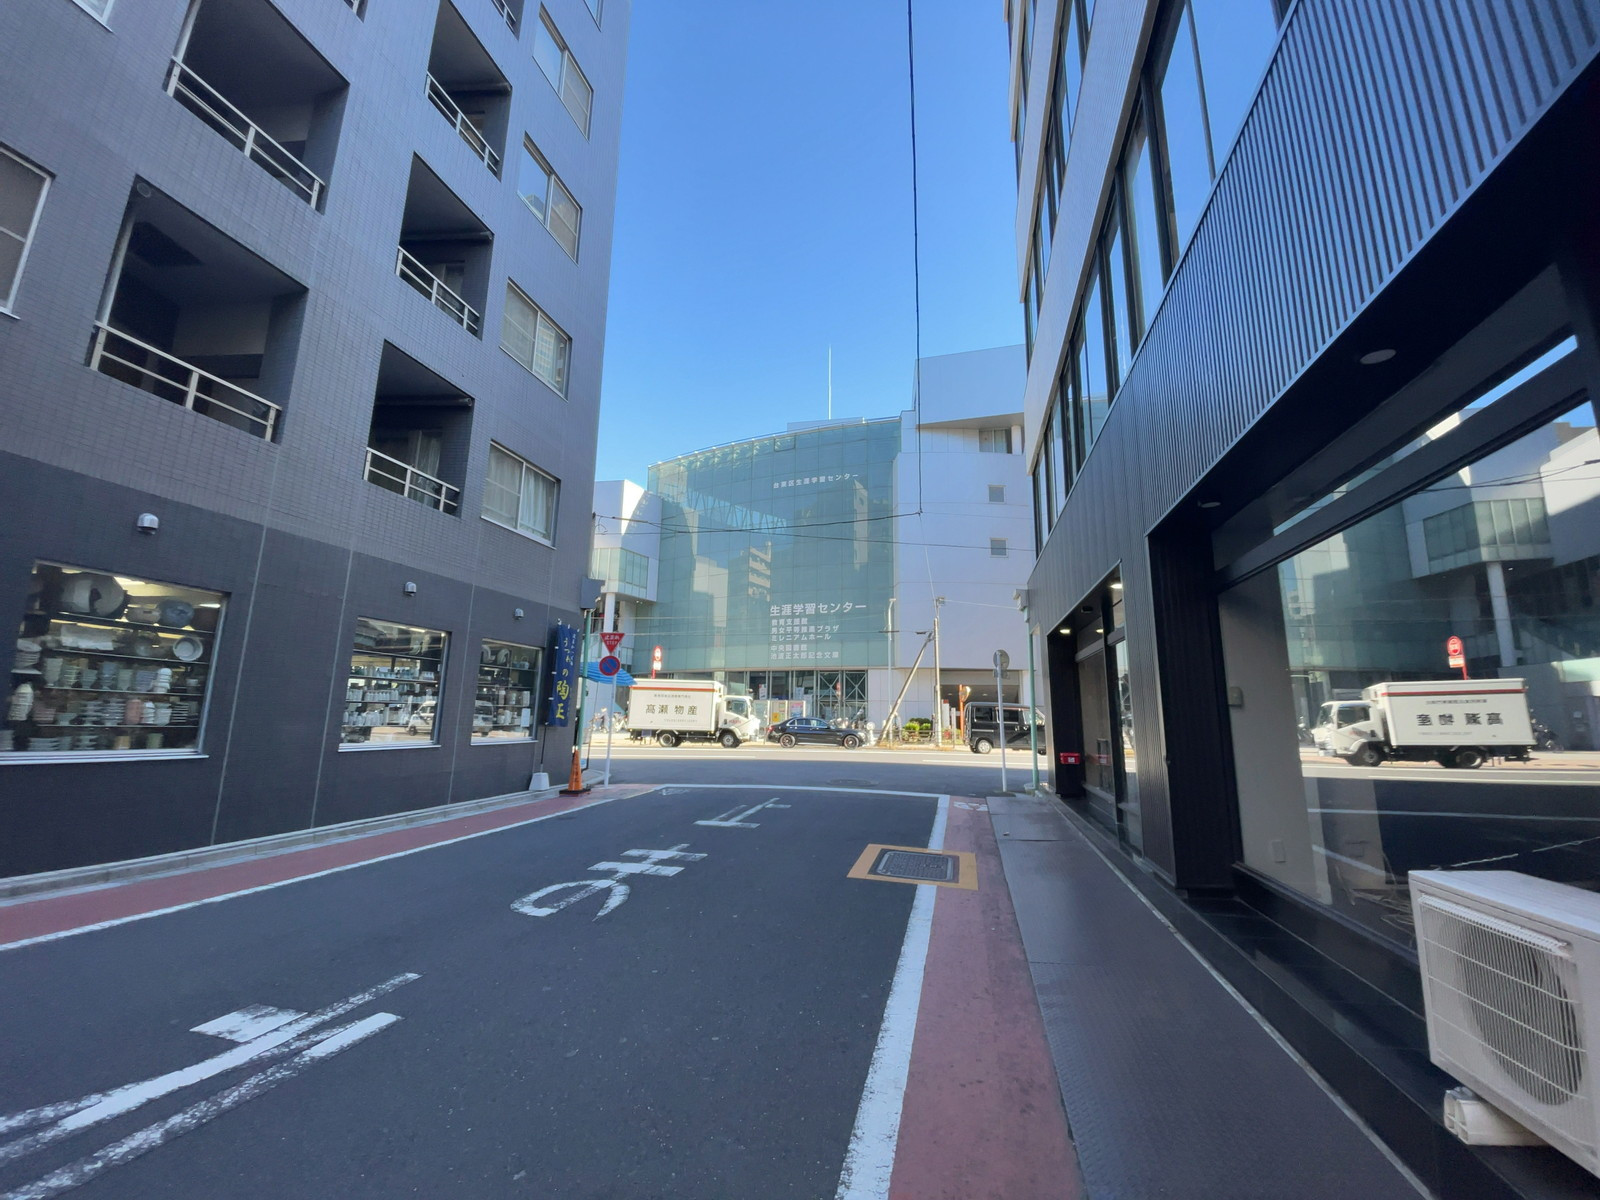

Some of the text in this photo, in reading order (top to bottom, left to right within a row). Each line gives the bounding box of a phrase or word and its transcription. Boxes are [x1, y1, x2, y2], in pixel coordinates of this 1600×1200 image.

[769, 602, 867, 617] 生涯学習センター
[771, 633, 832, 642] ミレニアムホール
